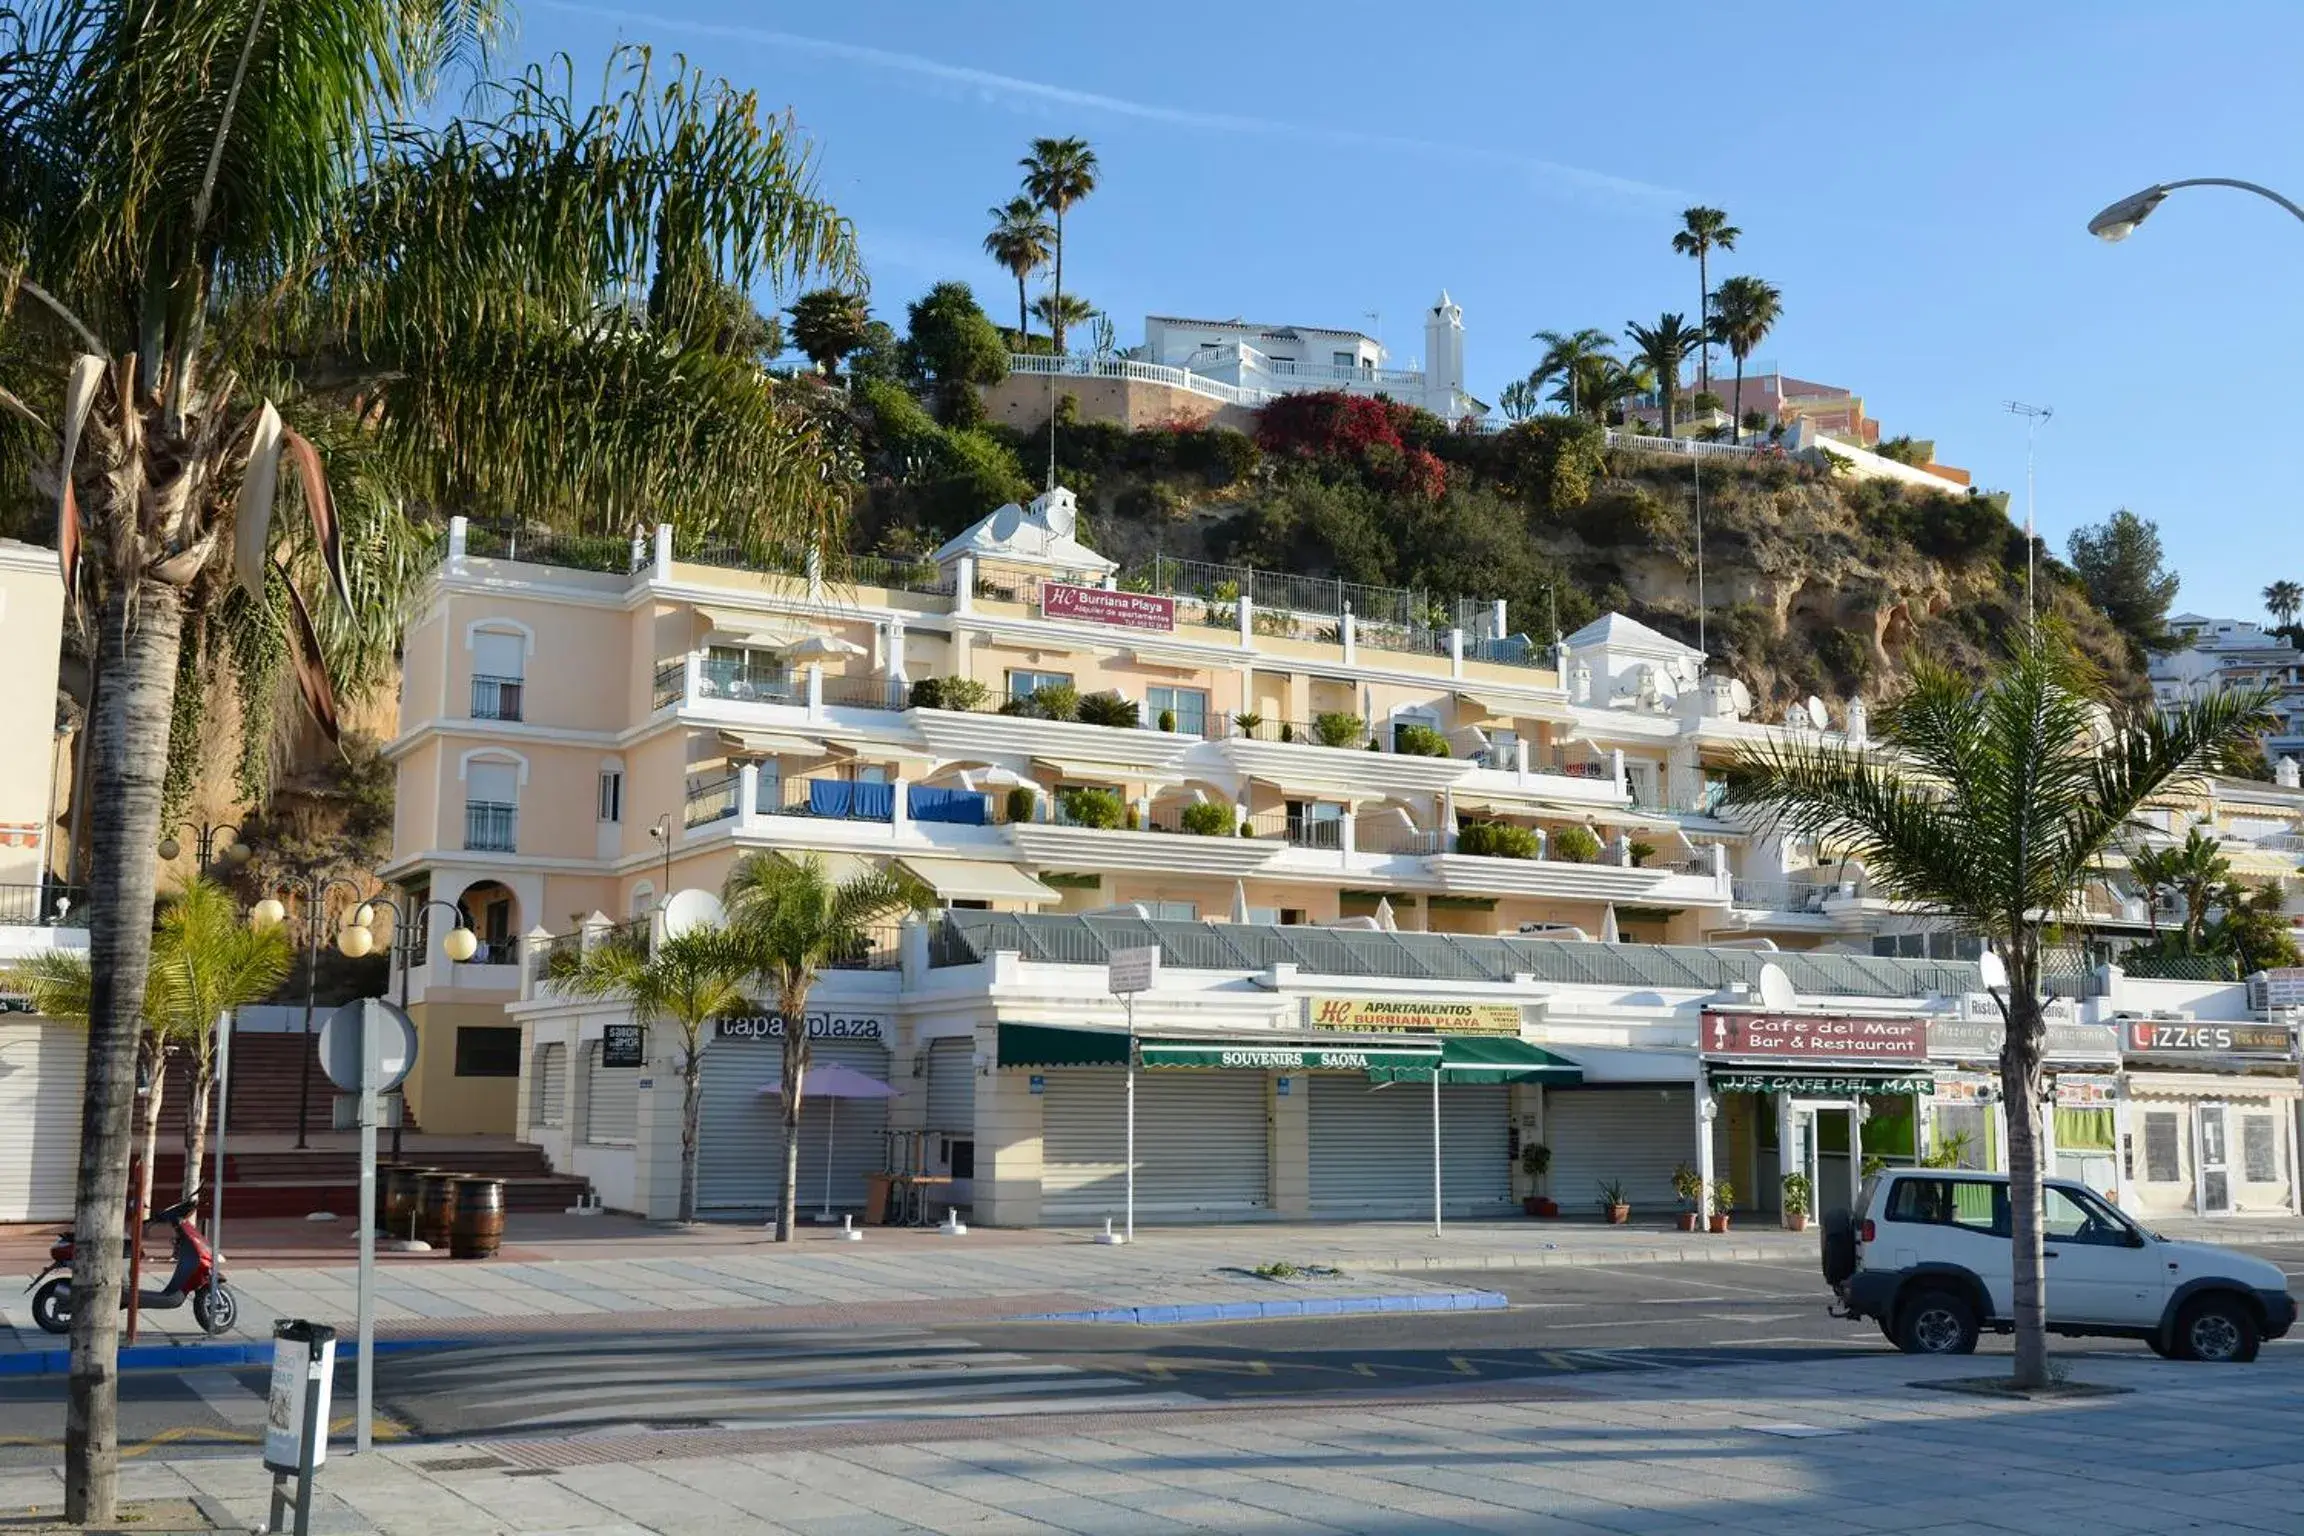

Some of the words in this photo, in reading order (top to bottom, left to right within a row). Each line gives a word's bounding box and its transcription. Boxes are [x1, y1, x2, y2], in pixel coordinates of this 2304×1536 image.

[1049, 588, 1076, 604] HC
[1080, 592, 1128, 608] Burriana
[1132, 599, 1162, 613] Playa
[1314, 1001, 1352, 1024] HC
[1364, 1002, 1473, 1015] APARTAMENTOS
[723, 1013, 786, 1040] tapa
[808, 1013, 882, 1040] plaza
[1354, 1014, 1431, 1026] BURRIANA
[1436, 1016, 1480, 1027] PLAYA
[1749, 1019, 1809, 1032] Cafe
[1818, 1019, 1853, 1033] del
[1864, 1023, 1912, 1035] Mar
[1750, 1035, 1783, 1048] Bar
[1790, 1036, 1804, 1049] &
[1811, 1037, 1916, 1050] Restaurant
[1222, 1052, 1302, 1065] SOUVENIRS
[1321, 1053, 1367, 1066] SAONA
[1723, 1076, 1764, 1088] JJ'S
[1772, 1077, 1827, 1089] CAFE
[1831, 1078, 1873, 1090] DEL
[1881, 1079, 1931, 1092] MAR
